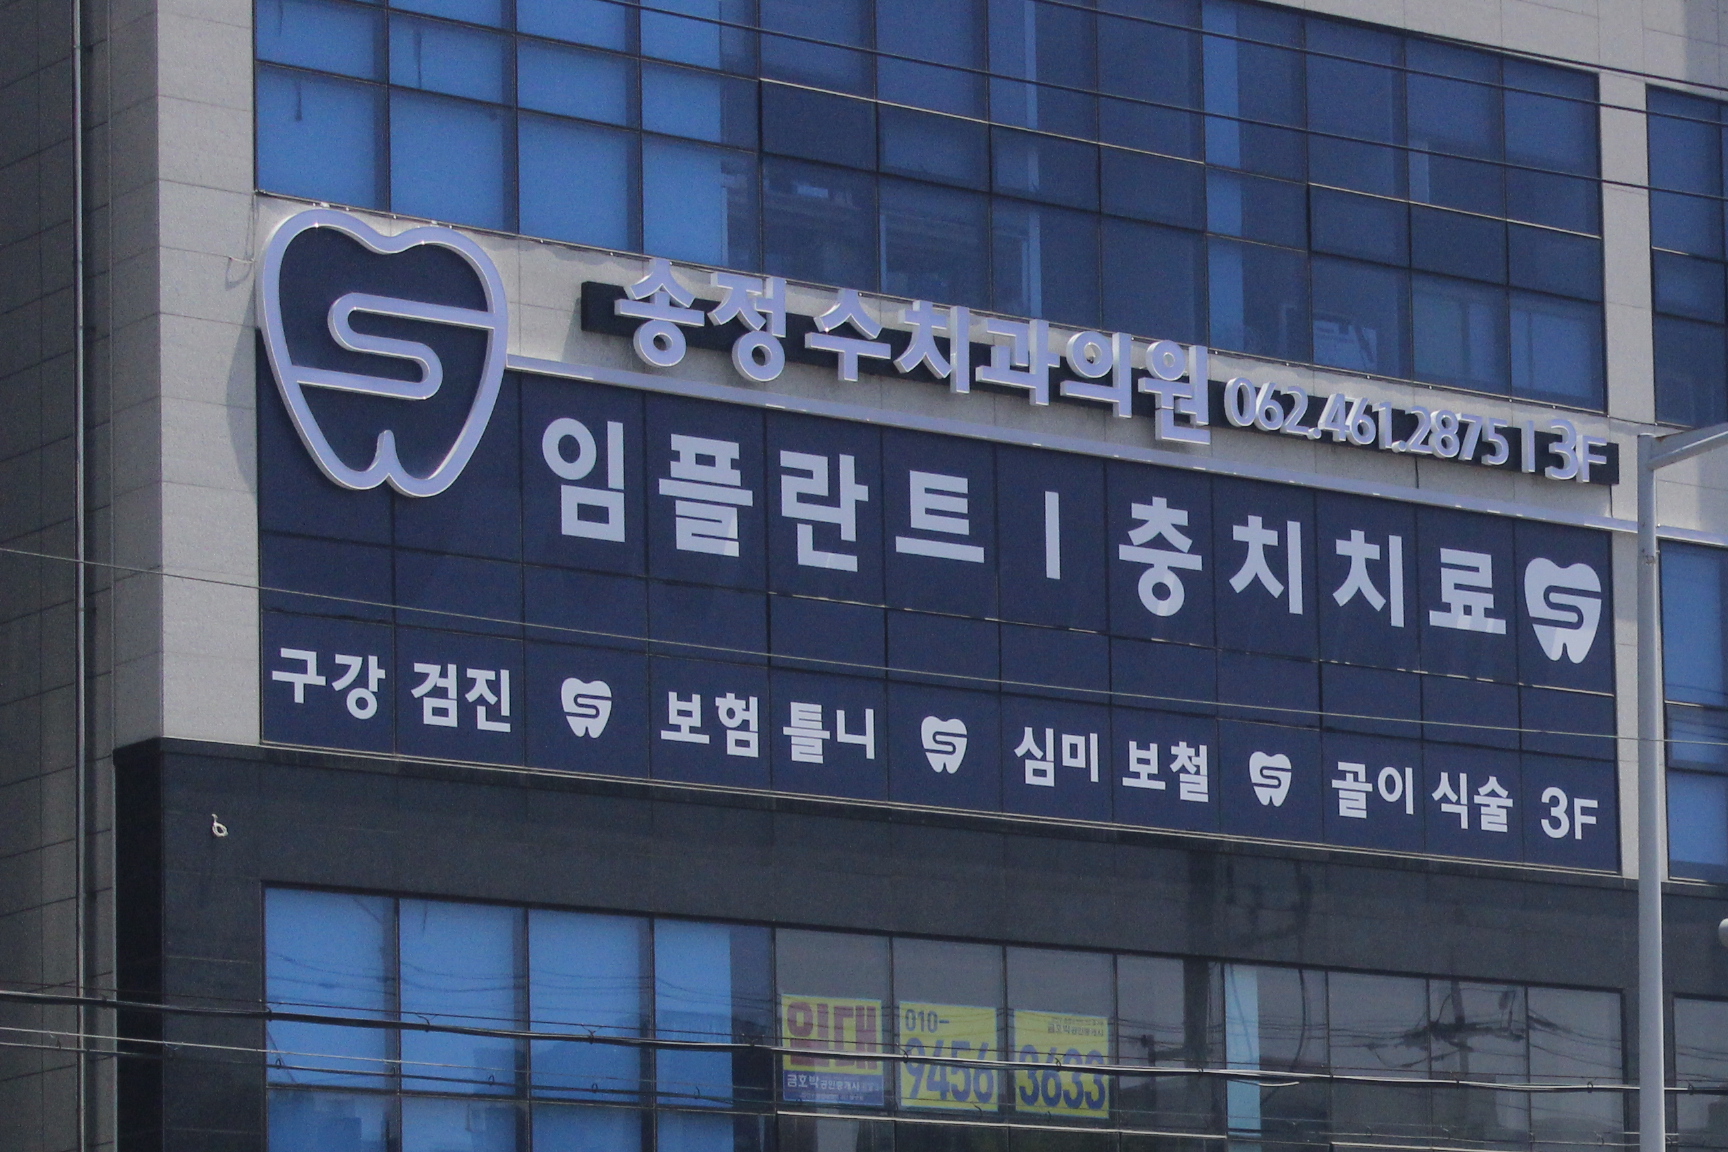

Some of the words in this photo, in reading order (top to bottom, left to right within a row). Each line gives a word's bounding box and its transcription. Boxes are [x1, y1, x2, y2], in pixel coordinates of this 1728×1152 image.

[614, 256, 1211, 446] 송정수치과의원
[1224, 376, 1511, 466] 062.461.2875
[540, 416, 985, 573] 임플란트
[271, 646, 387, 721] 구강
[410, 662, 512, 735] 검진
[660, 692, 760, 759] 보험
[782, 701, 876, 763] 틀니
[1014, 726, 1099, 788] 심미
[1122, 740, 1210, 805] 보철
[1331, 760, 1415, 820] 골이
[1431, 770, 1514, 834] 식술
[1540, 786, 1598, 841] 3F
[787, 1001, 878, 1071] 임대
[904, 1036, 996, 1106] 9456
[1018, 1042, 1107, 1110] 3633
